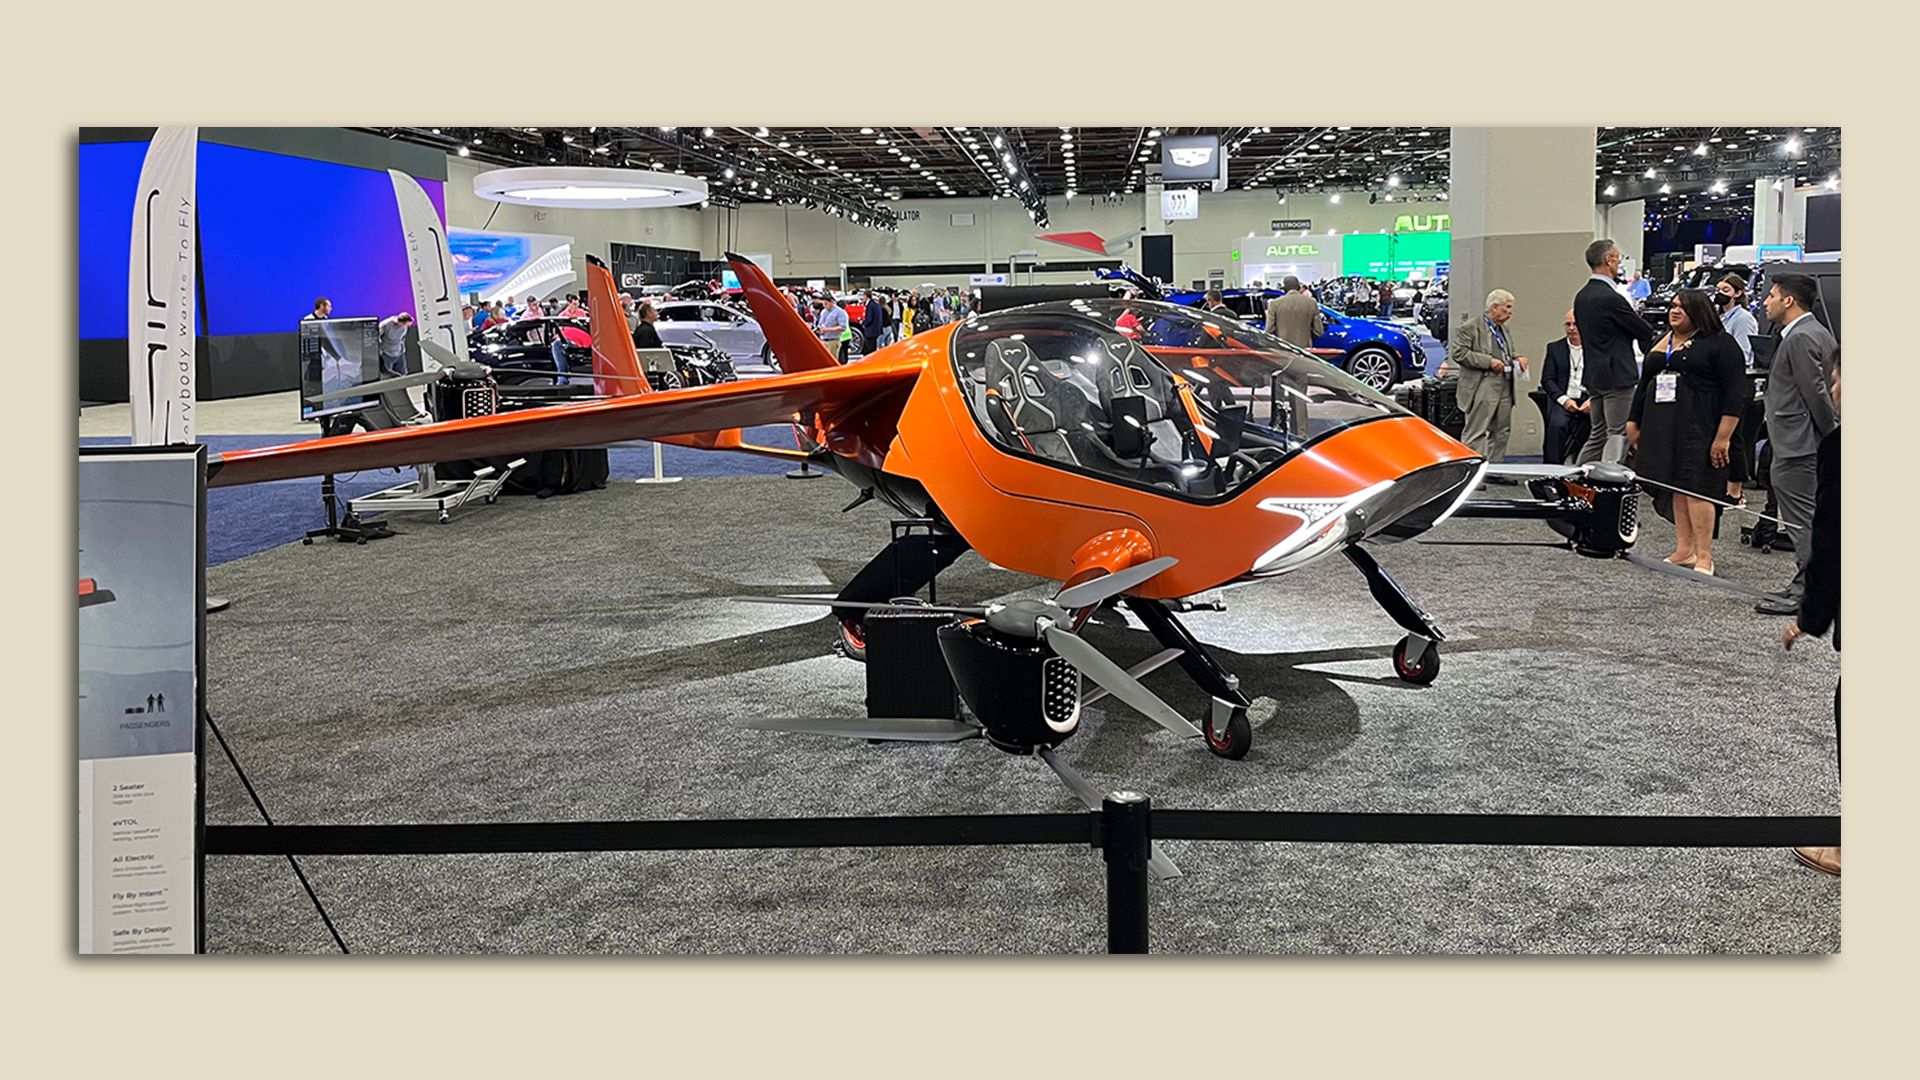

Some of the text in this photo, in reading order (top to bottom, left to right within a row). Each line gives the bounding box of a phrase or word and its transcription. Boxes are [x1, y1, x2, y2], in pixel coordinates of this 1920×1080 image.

[178, 197, 191, 227] Fly
[1272, 221, 1310, 229] RESTROOMS
[178, 239, 189, 262] To
[1266, 244, 1319, 256] AUTEL
[120, 720, 171, 729] PASSENGERS
[119, 783, 145, 791] Seater
[125, 854, 155, 862] Electric
[144, 926, 172, 934] Design
